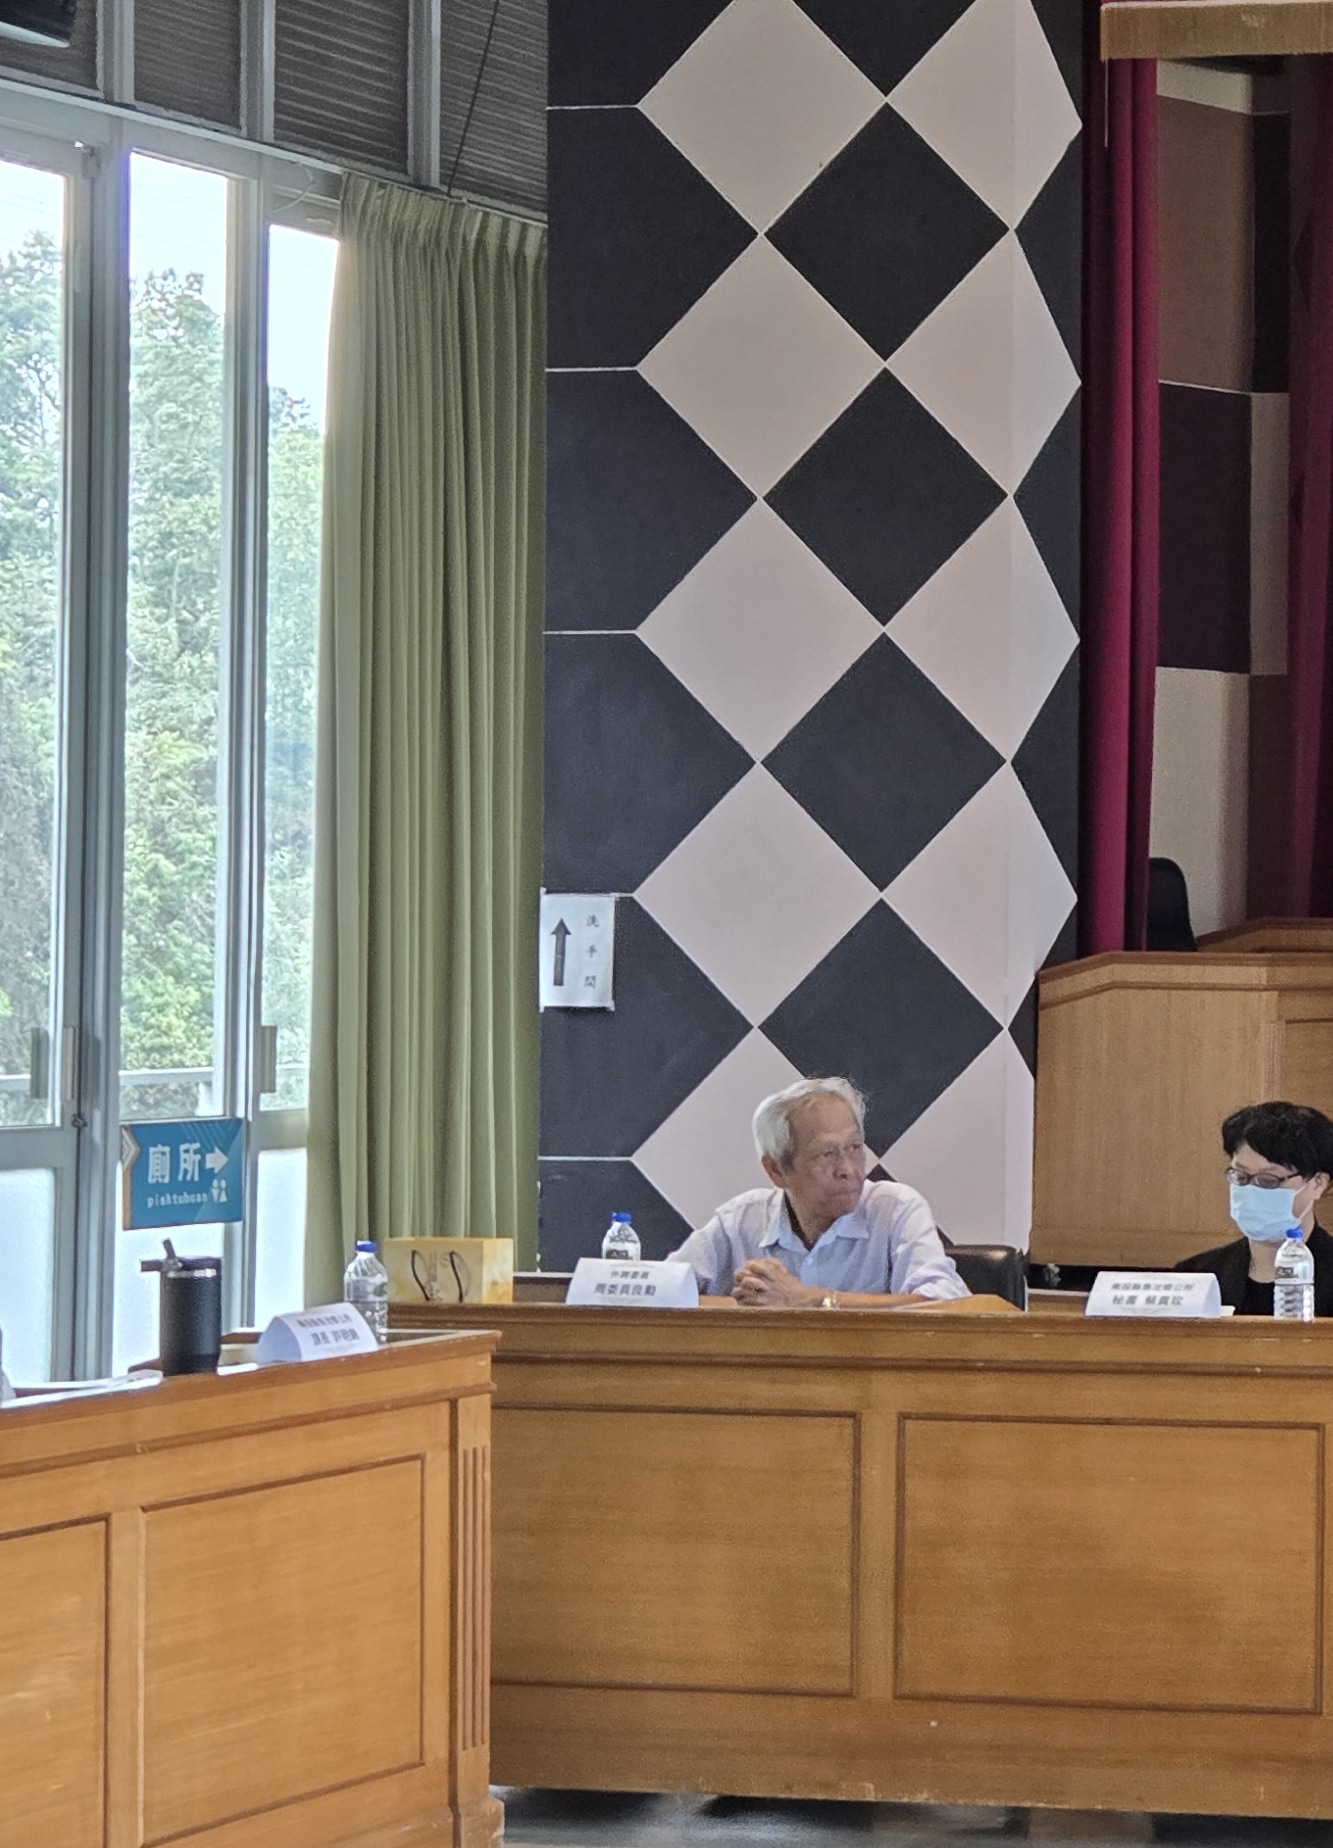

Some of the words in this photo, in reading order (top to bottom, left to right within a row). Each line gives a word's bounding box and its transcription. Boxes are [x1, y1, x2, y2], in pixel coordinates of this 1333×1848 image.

[584, 914, 599, 989] 洗手間
[148, 1142, 201, 1184] 廁所
